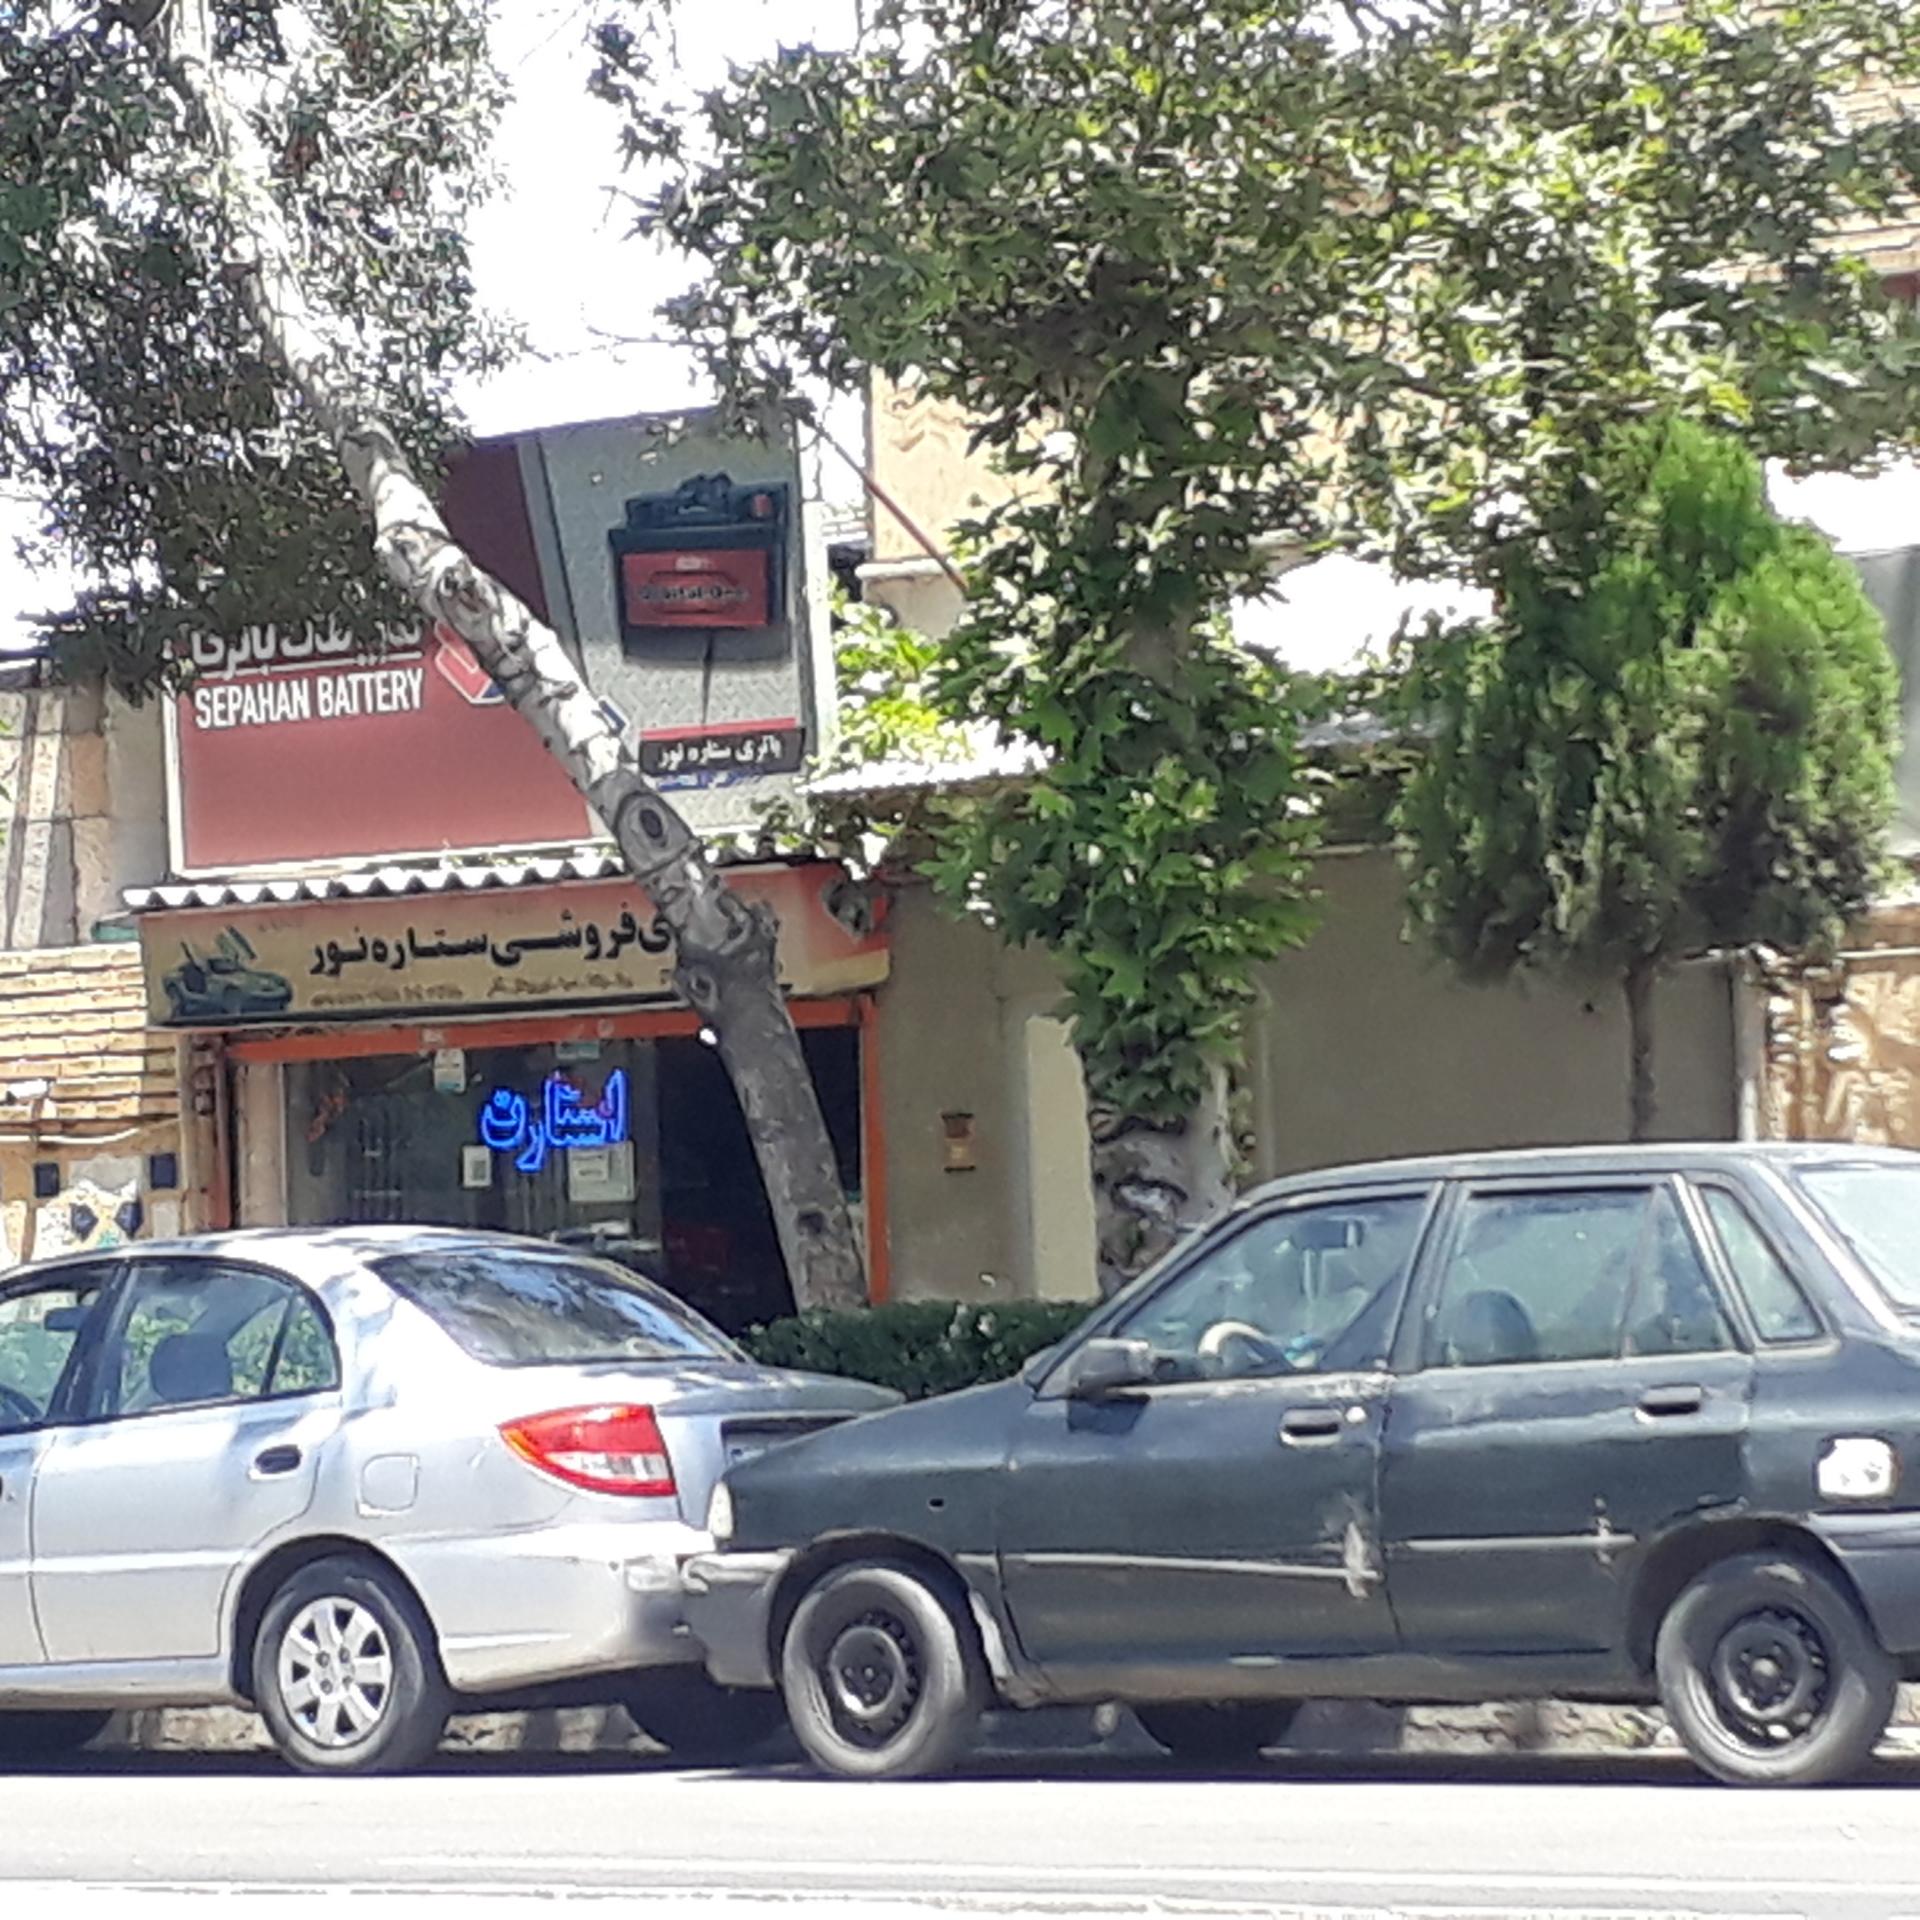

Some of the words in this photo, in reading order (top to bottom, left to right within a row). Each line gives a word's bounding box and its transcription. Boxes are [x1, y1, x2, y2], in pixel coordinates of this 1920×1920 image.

[194, 675, 311, 730] SEPAHAN
[317, 668, 424, 718] BATTERY
[658, 741, 685, 771] نور
[687, 739, 731, 766] ستاره
[734, 733, 783, 764] باتری
[309, 926, 368, 977] نور
[371, 926, 488, 971] ستاره
